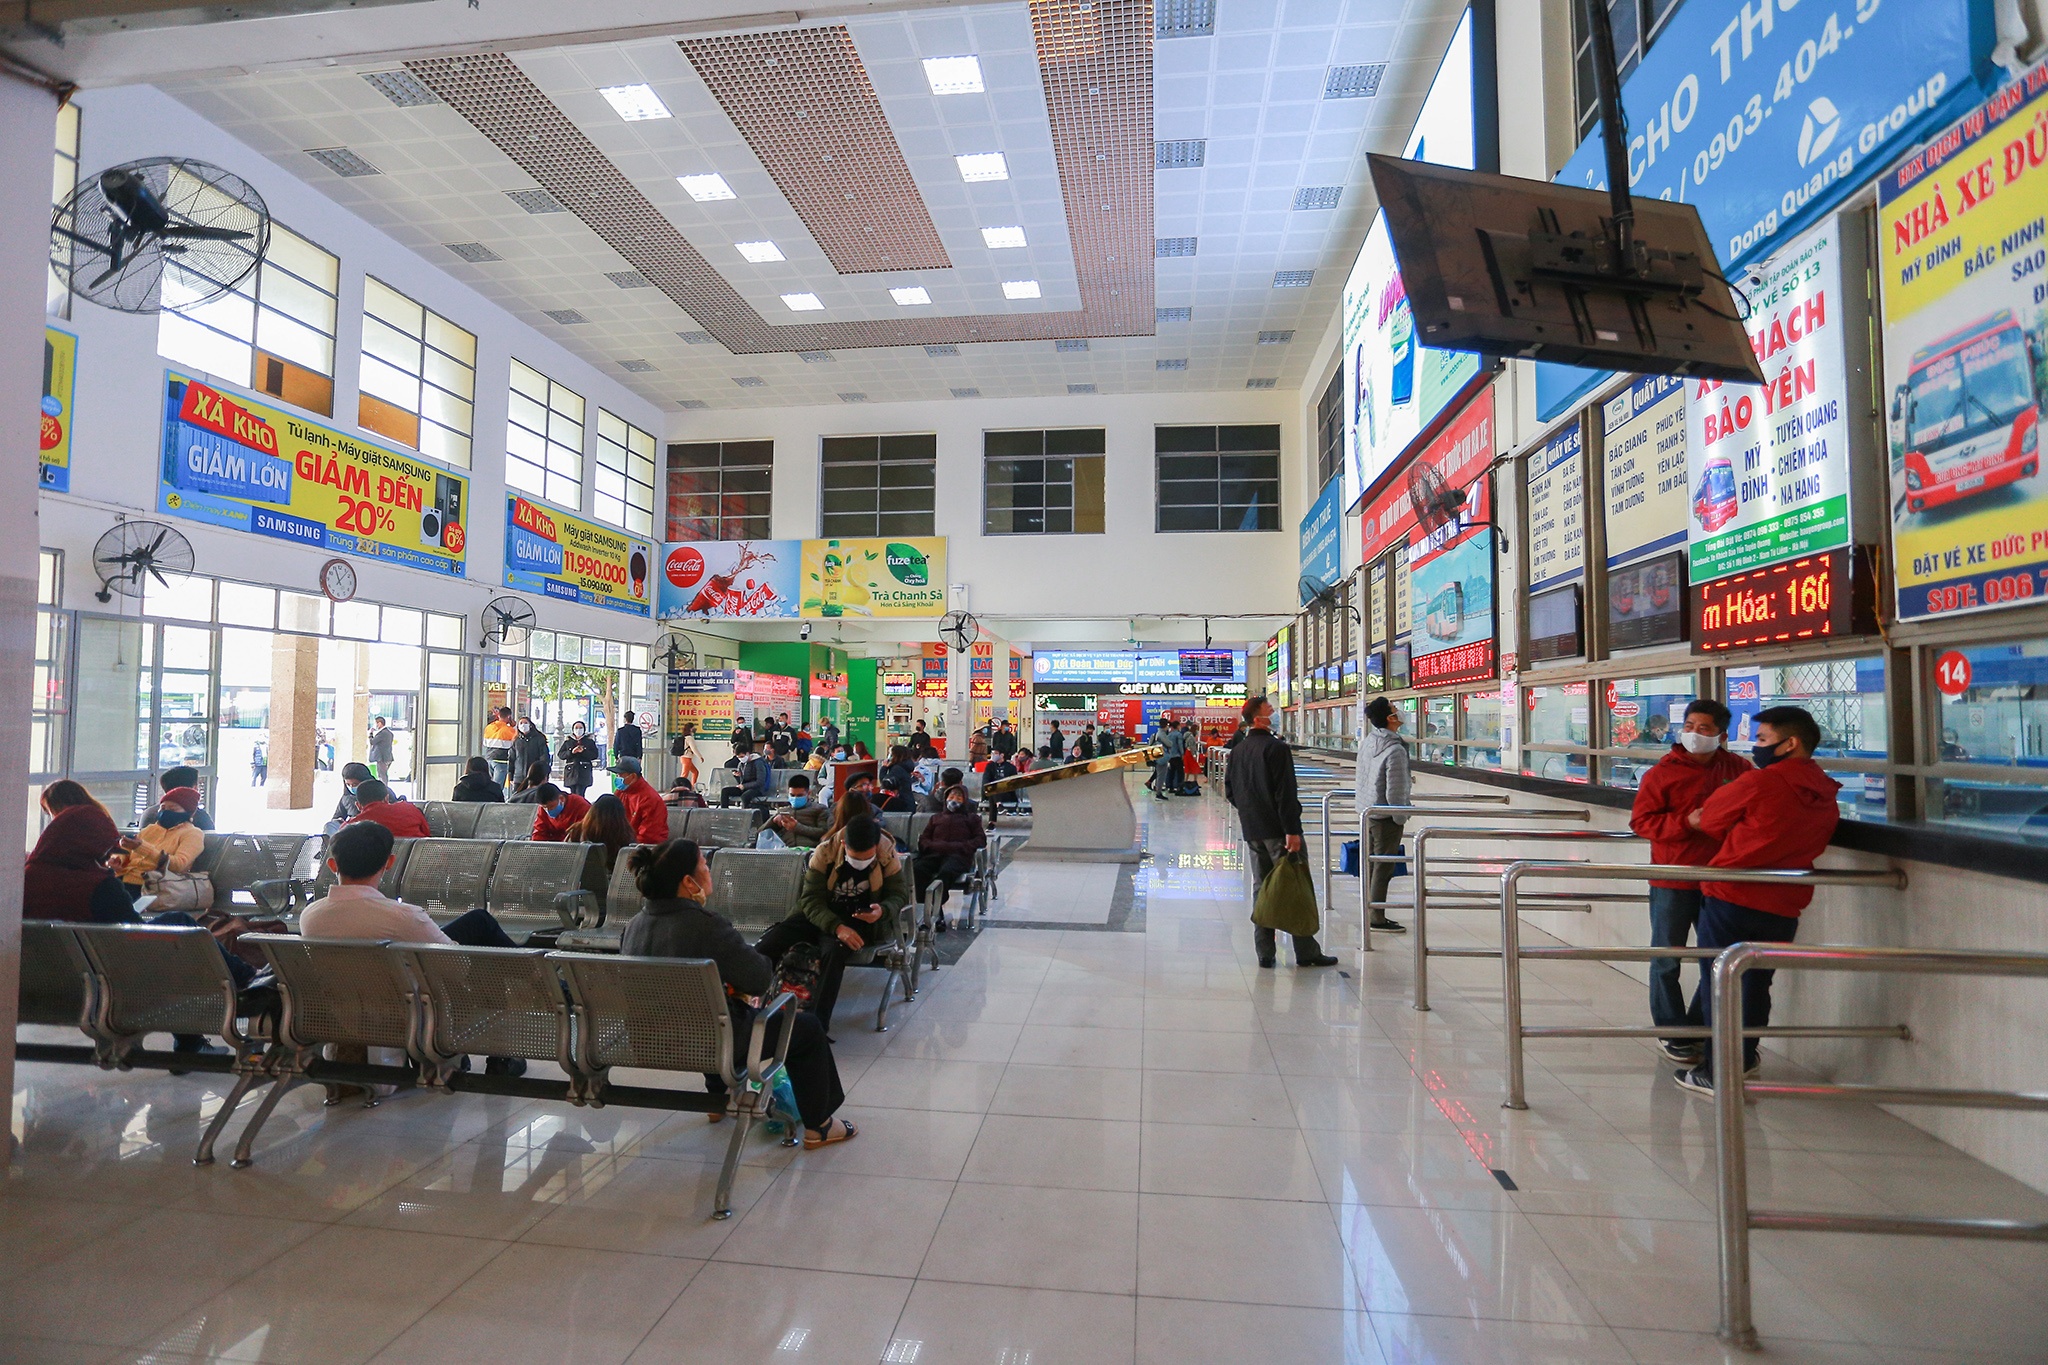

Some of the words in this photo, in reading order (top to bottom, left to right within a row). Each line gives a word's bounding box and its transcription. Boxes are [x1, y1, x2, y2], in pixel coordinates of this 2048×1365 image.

[1628, 73, 1699, 188] CHO
[1711, 0, 1799, 85] TH
[1730, 209, 1777, 261] Dong
[1781, 145, 1852, 217] Quang
[1858, 71, 1946, 155] Group
[1898, 152, 1925, 189] HTX
[1926, 127, 1961, 166] DỊCH
[1964, 108, 1985, 139] VỤ
[1956, 156, 1996, 217] XE
[1901, 255, 1922, 286] MỸ
[1926, 234, 1961, 271] ĐÌNH
[1964, 245, 1995, 279] BẮC
[2001, 216, 2045, 257] NINH
[1781, 258, 1798, 277] ĐOÀN
[2011, 248, 2045, 283] SAO
[1763, 288, 1779, 309] VÉ
[1782, 270, 1799, 297] SỐ
[1804, 261, 1821, 283] 13
[1749, 289, 1825, 363] HÁCH
[1703, 395, 1753, 447] BẢO
[1761, 354, 1816, 417] YẾN
[193, 390, 226, 429] XẢ
[233, 411, 274, 450] KHO
[1656, 412, 1674, 435] PHÚC
[1776, 415, 1803, 445] TUYÊN
[1806, 400, 1838, 433] QUANG
[287, 422, 303, 439] Tủ
[304, 427, 331, 448] lạnh
[338, 440, 361, 461] Máy
[362, 449, 382, 467] giặt
[382, 456, 431, 482] SAMSUNG
[1608, 441, 1623, 462] BẮC
[1624, 429, 1648, 455] GIANG
[1656, 435, 1678, 455] THANH
[1671, 450, 1685, 469] LẠC
[1744, 441, 1761, 472] MỸ
[1778, 446, 1806, 477] CHIÊM
[1808, 437, 1828, 466] HÓA
[188, 443, 247, 482] GIẢM
[250, 461, 287, 491] LỚN
[296, 450, 371, 498] GIẢM
[377, 474, 423, 513] ĐẾN
[1466, 480, 1483, 517] 1
[1658, 479, 1673, 495] TAM
[1741, 473, 1768, 504] ĐÌNH
[1781, 486, 1793, 506] NA
[1795, 473, 1820, 500] HANG
[335, 495, 395, 536] 20%
[518, 503, 533, 527] XẢ
[535, 514, 555, 538] KHO
[1611, 500, 1624, 516] TAM
[257, 514, 321, 540] SAMSUNG
[446, 532, 464, 548] 0%
[563, 522, 580, 540] Máy
[580, 529, 594, 544] giặt
[594, 531, 627, 553] SAMSUNG
[329, 533, 354, 550] Trúng
[356, 537, 380, 556] 2021
[397, 549, 419, 566] phẩm
[420, 556, 434, 566] cao
[435, 556, 449, 570] cấp
[516, 537, 542, 561] GIẢM
[544, 546, 560, 565] LỚN
[564, 550, 627, 585] 11.990.000
[1913, 553, 1939, 577] ĐẶT
[1944, 545, 1961, 569] VÉ
[1966, 543, 1986, 565] XE
[1992, 533, 2025, 560] ĐỨC
[546, 583, 577, 597] SAMSUNG
[872, 590, 889, 601] Trà
[892, 590, 928, 601] Chanh
[930, 589, 943, 601] Sả
[1726, 588, 1777, 627] Hóa:
[1927, 583, 1977, 613] SĐT:
[1984, 573, 2033, 604] 096
[1149, 657, 1165, 667] ĐÌNH
[1940, 659, 1966, 685] 14
[1194, 683, 1215, 694] TAY
[1529, 695, 1536, 707] 11
[1607, 690, 1616, 703] 12
[1099, 712, 1108, 720] 37
[1180, 714, 1202, 724] ĐỨC
[1204, 715, 1233, 724] PHÚC
